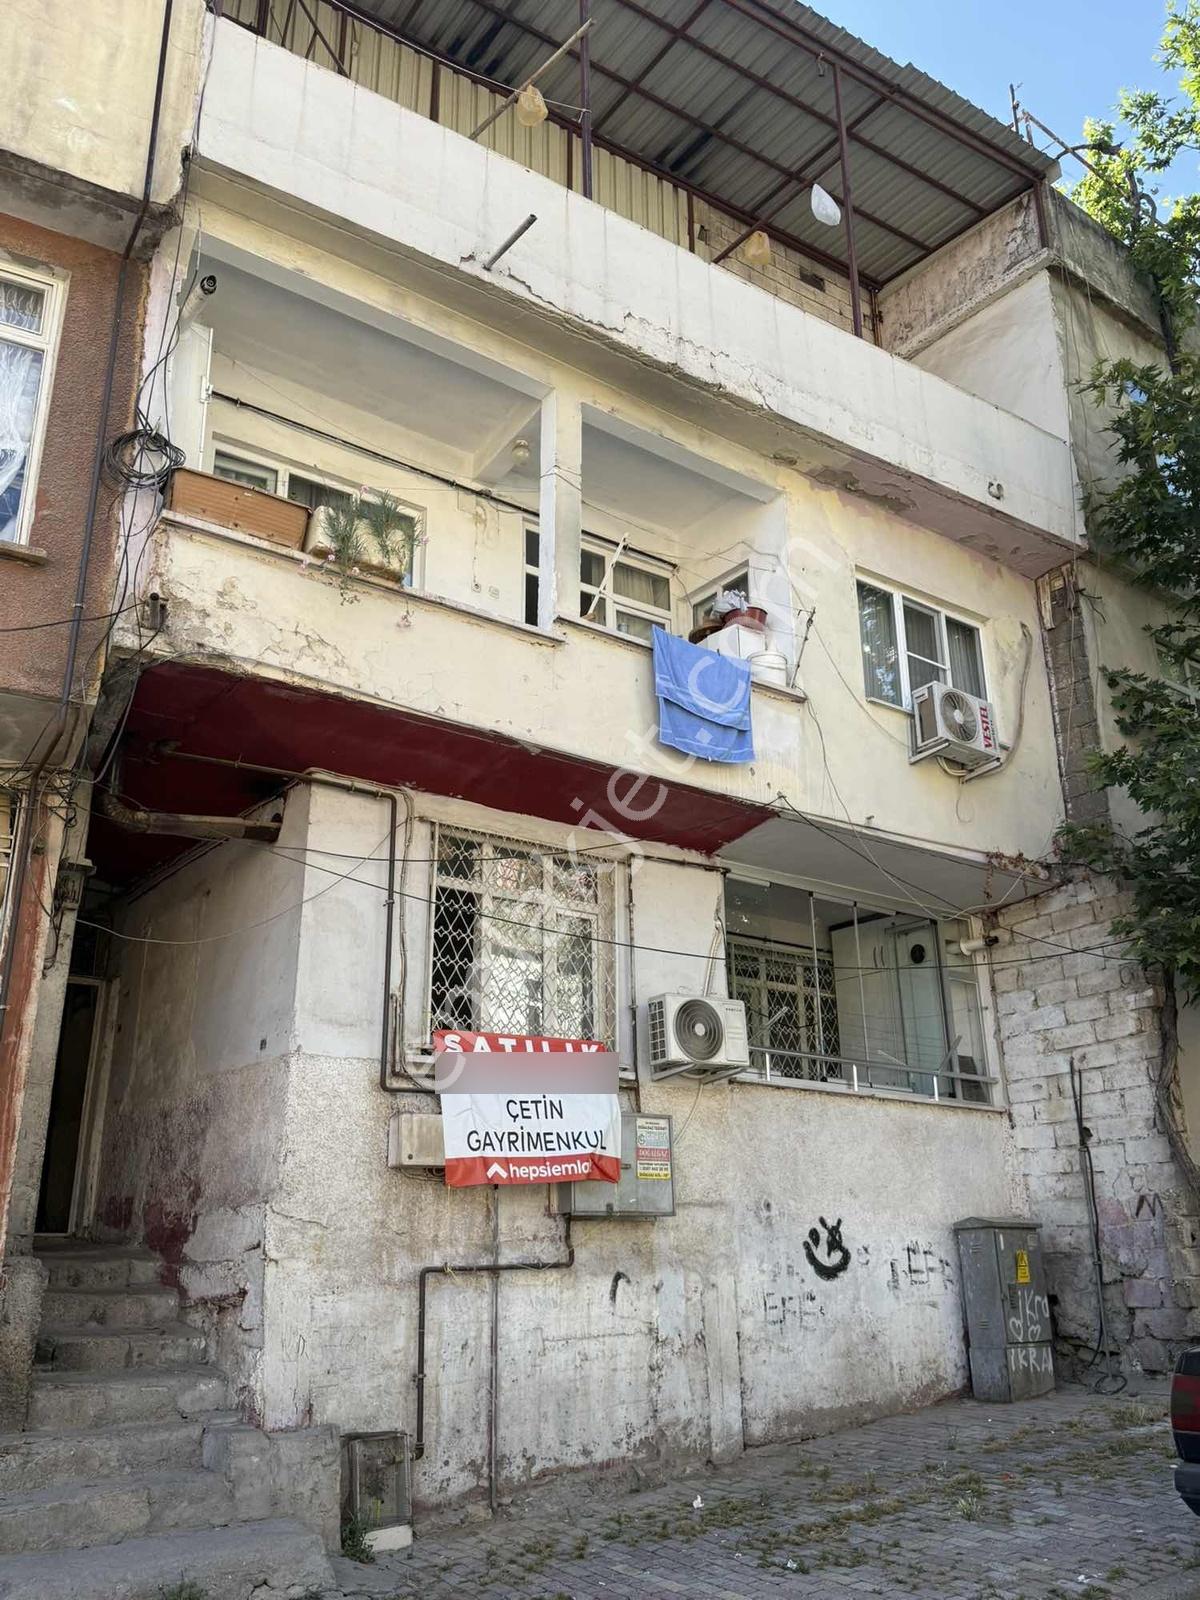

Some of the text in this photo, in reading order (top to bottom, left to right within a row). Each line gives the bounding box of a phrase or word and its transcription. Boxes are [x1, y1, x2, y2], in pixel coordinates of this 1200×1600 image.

[980, 706, 992, 748] VESTEL
[506, 1095, 564, 1122] ÇETİN
[466, 1126, 607, 1152] GAYRİMENKUL
[509, 1159, 592, 1181] hepsiemla
